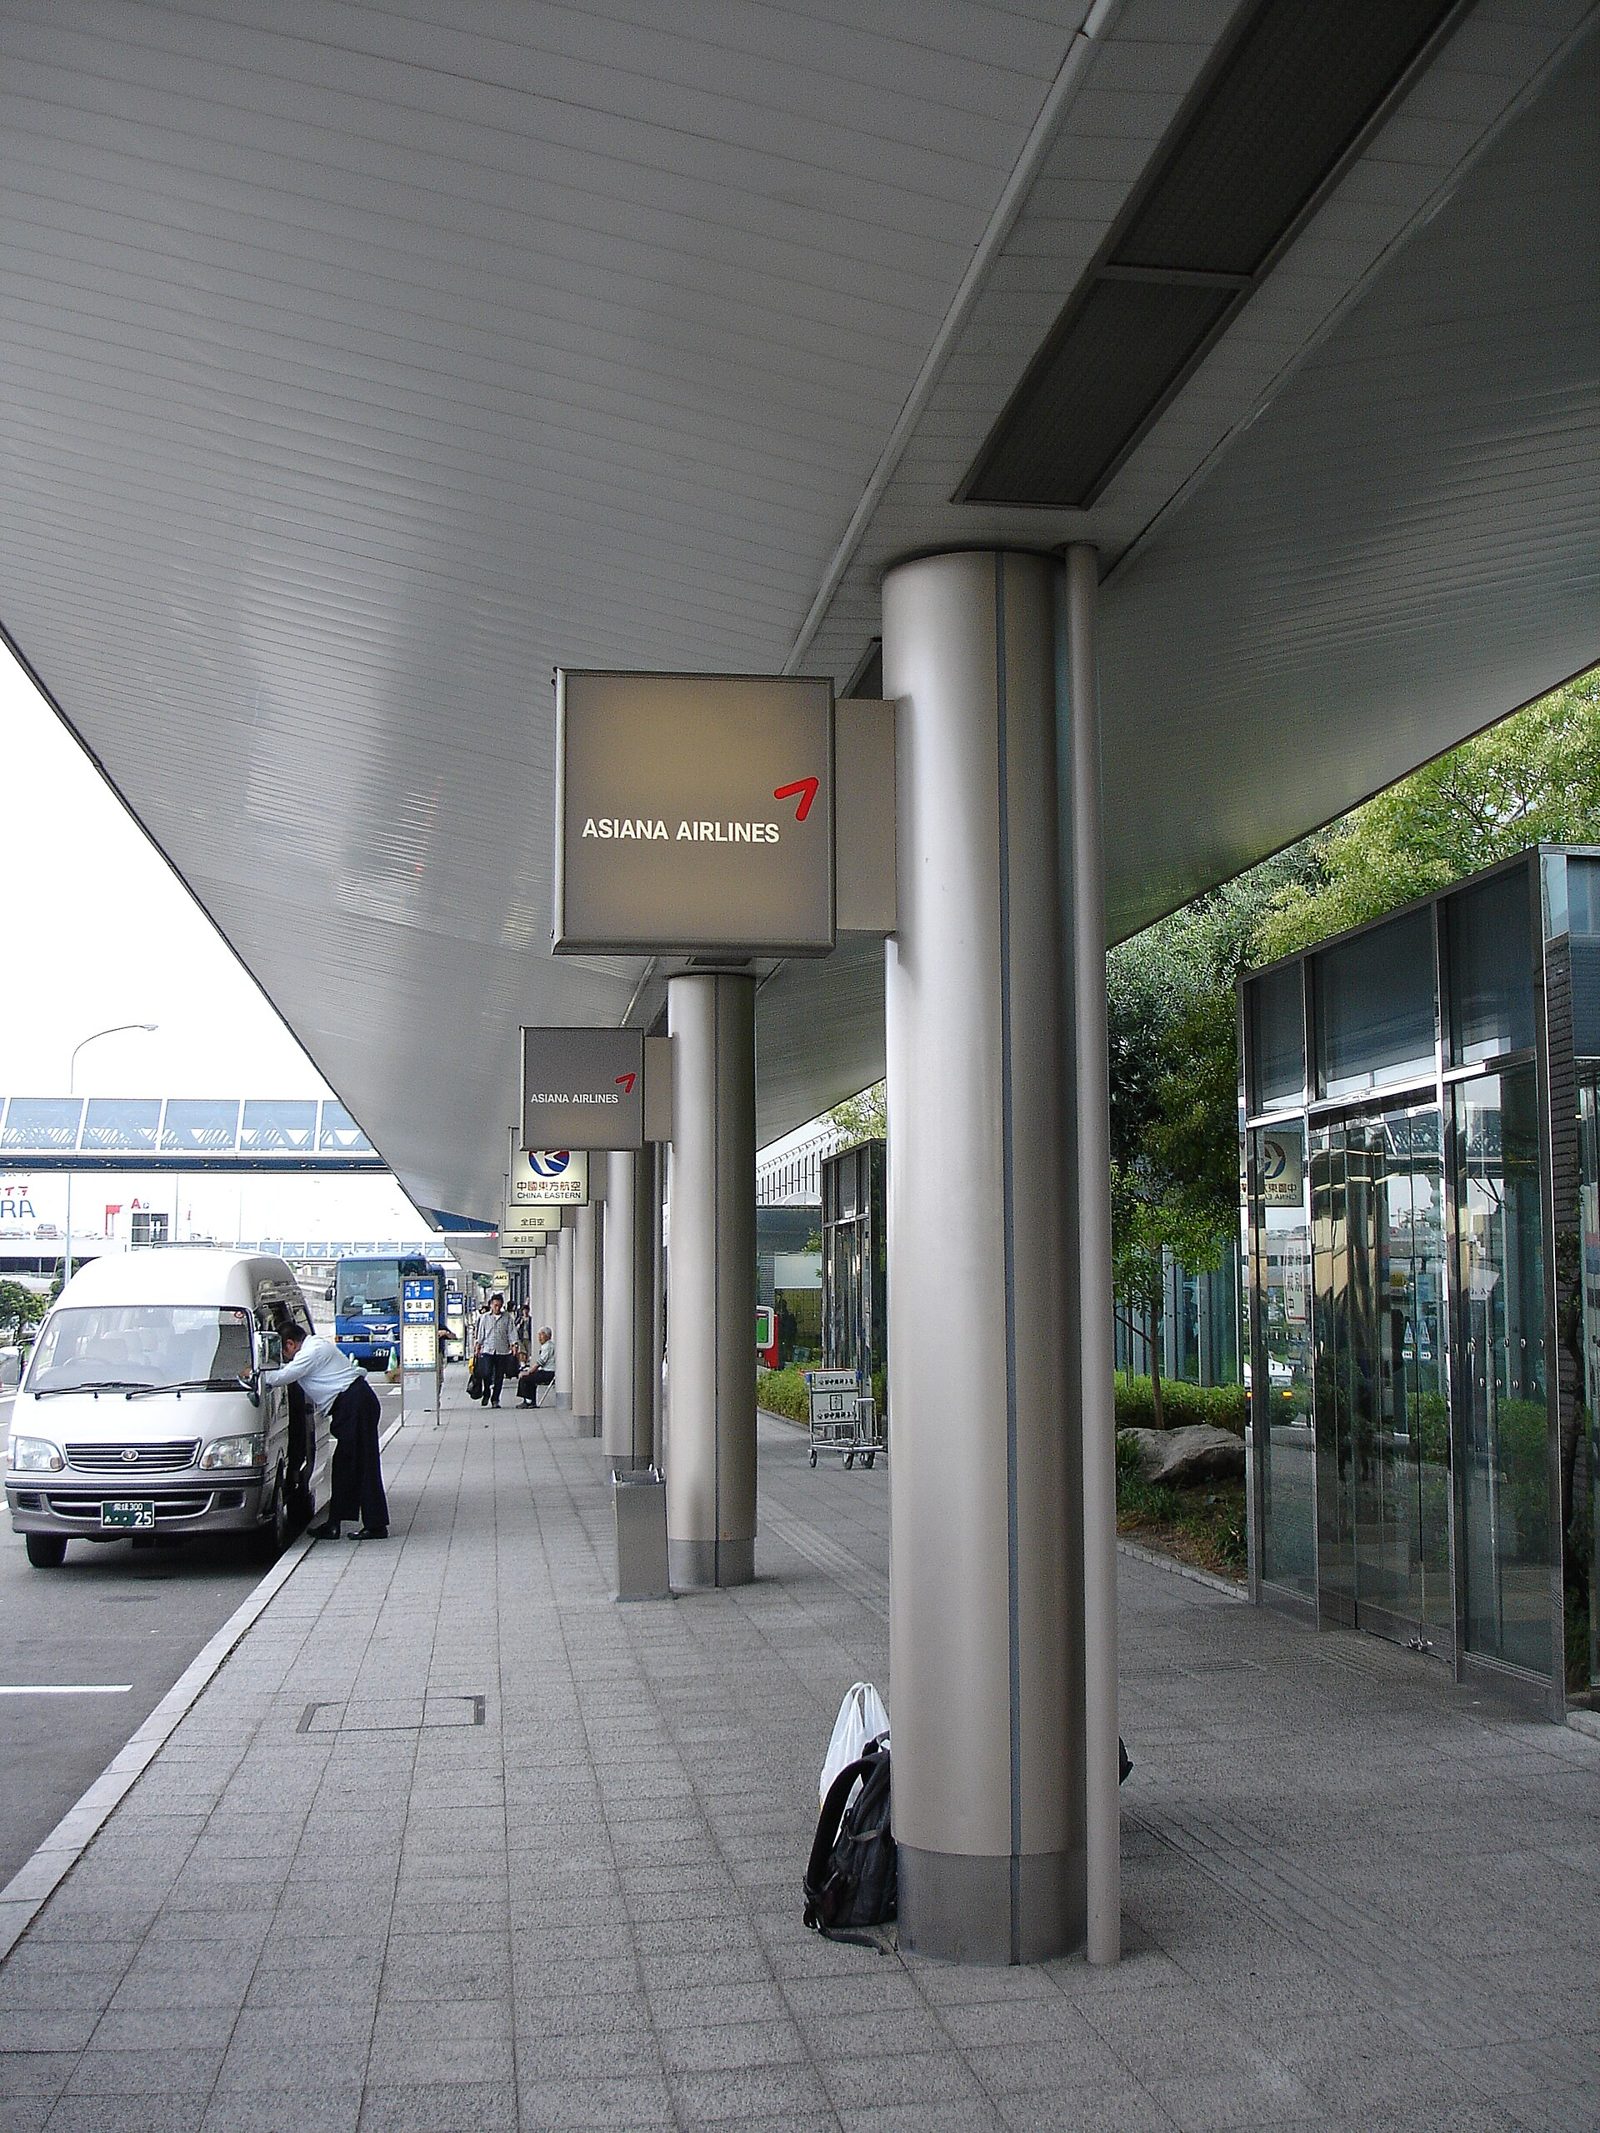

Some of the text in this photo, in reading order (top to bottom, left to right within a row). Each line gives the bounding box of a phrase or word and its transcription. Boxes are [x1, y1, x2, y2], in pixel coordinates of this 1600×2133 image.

[581, 818, 780, 843] ASIANA AIRLINES
[530, 1093, 619, 1104] ASIANA AIRLINES
[520, 1217, 546, 1227] 全日空
